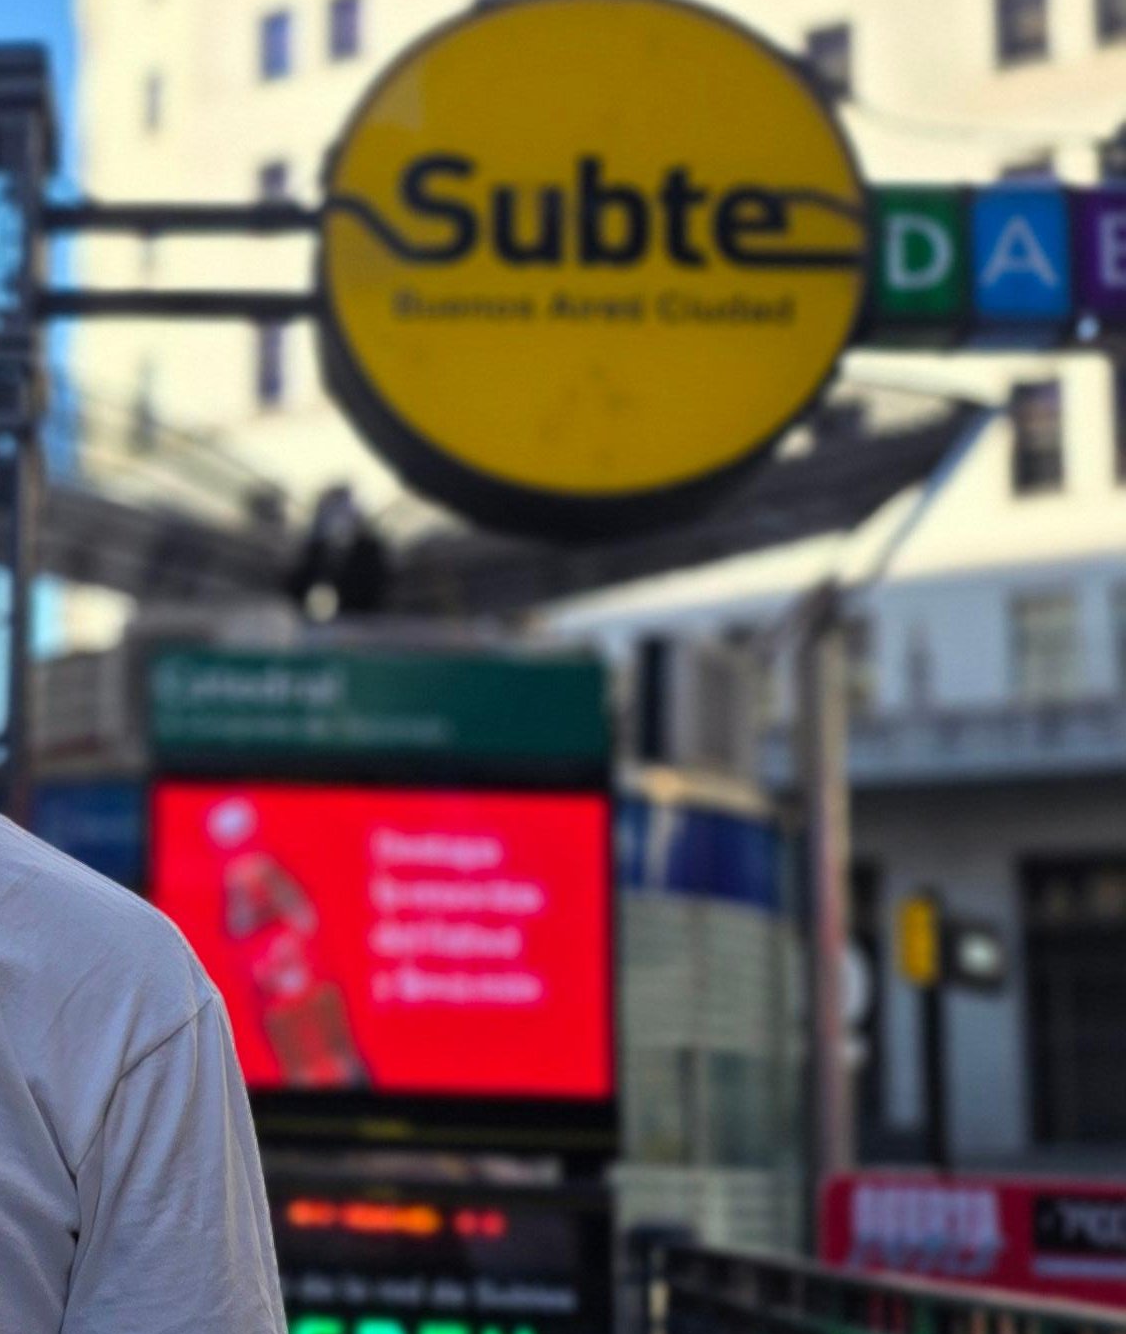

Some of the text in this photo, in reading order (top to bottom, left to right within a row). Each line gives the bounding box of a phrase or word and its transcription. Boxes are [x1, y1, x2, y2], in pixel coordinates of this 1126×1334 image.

[398, 153, 796, 269] Subte
[885, 215, 954, 291] D
[979, 215, 1060, 289] A
